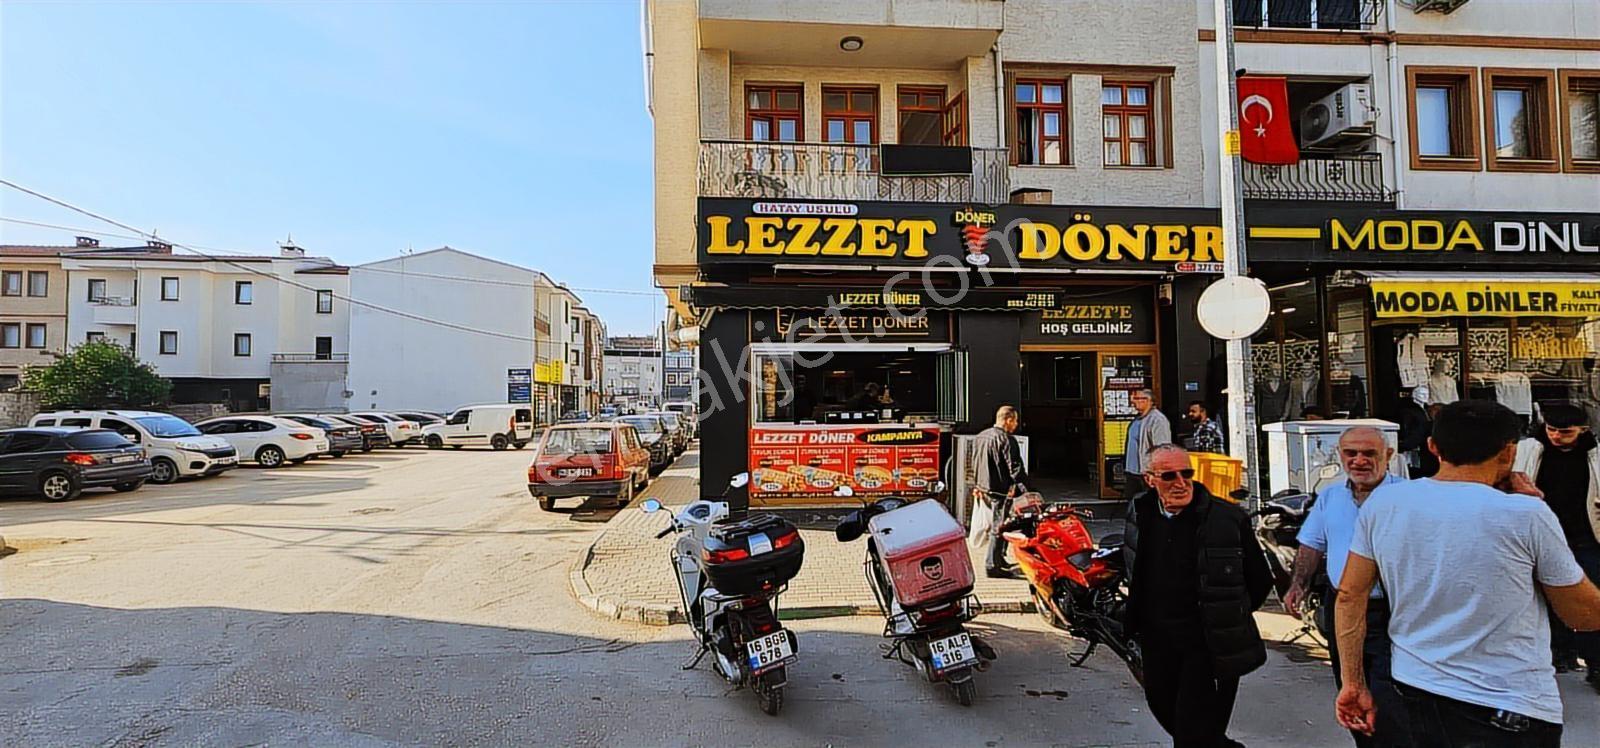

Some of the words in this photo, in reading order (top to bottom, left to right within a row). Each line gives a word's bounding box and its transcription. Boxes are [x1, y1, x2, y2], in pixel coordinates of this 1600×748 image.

[759, 203, 800, 214] HATAY
[955, 207, 996, 223] DÖNER
[706, 215, 937, 257] LEZZET
[1018, 213, 1224, 261] DÖNER
[1331, 219, 1484, 251] MODA
[840, 292, 880, 305] LEZZET
[883, 291, 920, 305] DÖNER
[1375, 291, 1459, 312] MODA
[1466, 286, 1558, 312] DİNLER
[808, 316, 868, 328] LEZZET
[1041, 324, 1069, 336] HOŞ
[1072, 322, 1133, 334] GELDİNİZ
[754, 432, 806, 444] LEZZET
[809, 430, 856, 444] DÖNER
[867, 431, 923, 442] KAMPANYA
[749, 640, 762, 654] 16
[764, 632, 786, 648] BGB
[932, 642, 944, 654] 16
[948, 634, 968, 650] ALP
[760, 647, 782, 663] 678
[942, 650, 962, 664] 316
